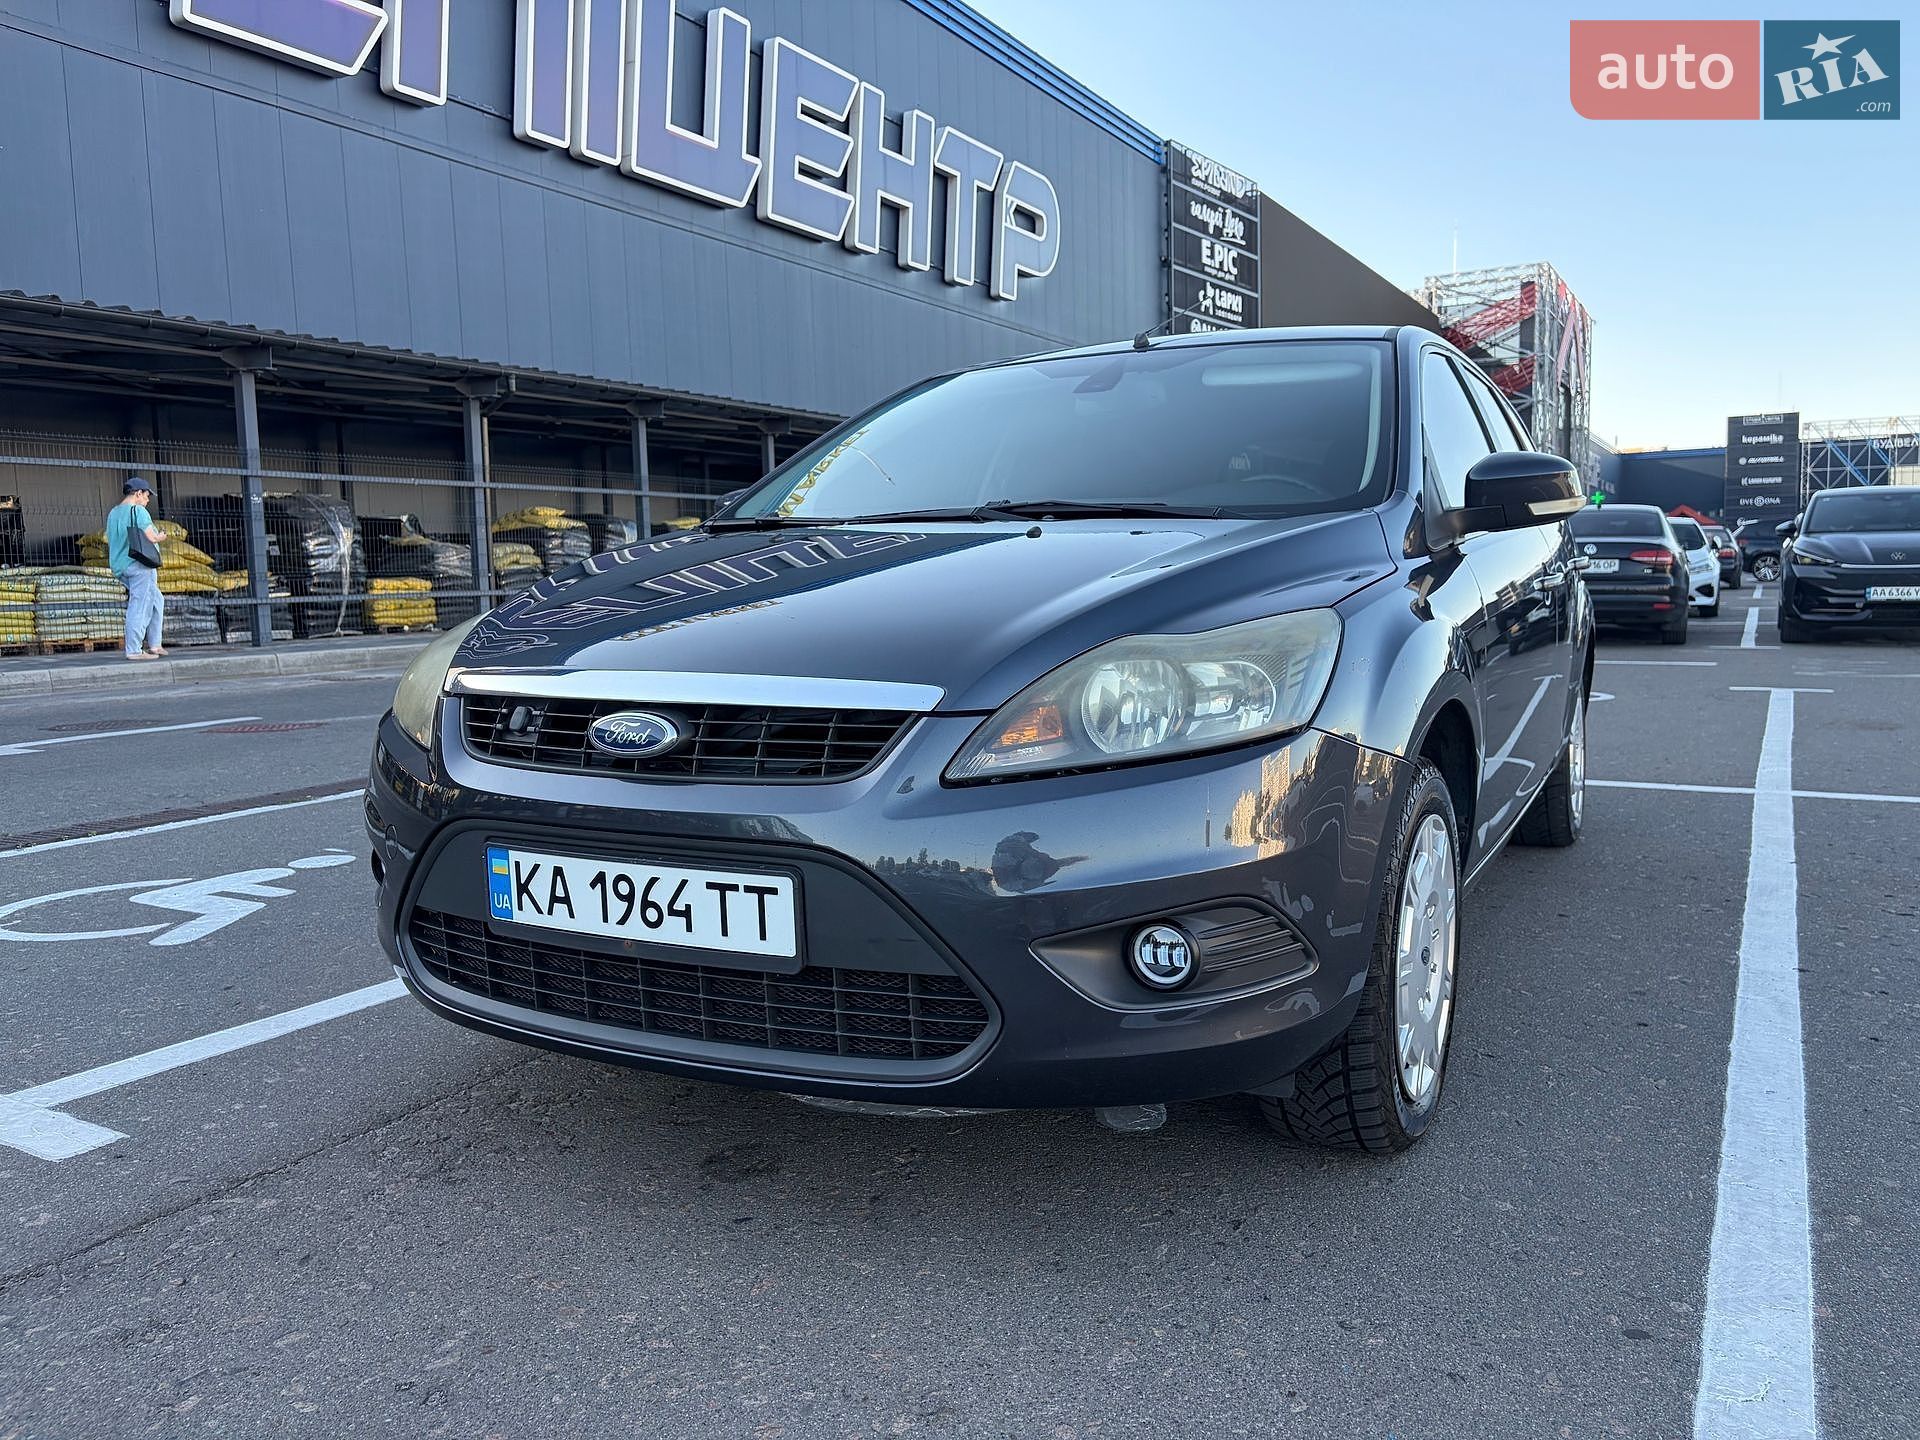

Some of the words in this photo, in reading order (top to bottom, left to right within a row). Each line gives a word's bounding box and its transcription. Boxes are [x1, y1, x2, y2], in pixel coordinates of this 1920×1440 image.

[1871, 588, 1887, 597] AA
[1888, 588, 1912, 597] 6366
[605, 720, 650, 745] Ford
[494, 893, 511, 910] UA
[514, 860, 575, 919] KA
[589, 870, 693, 933] 1964
[705, 881, 779, 941] TT
